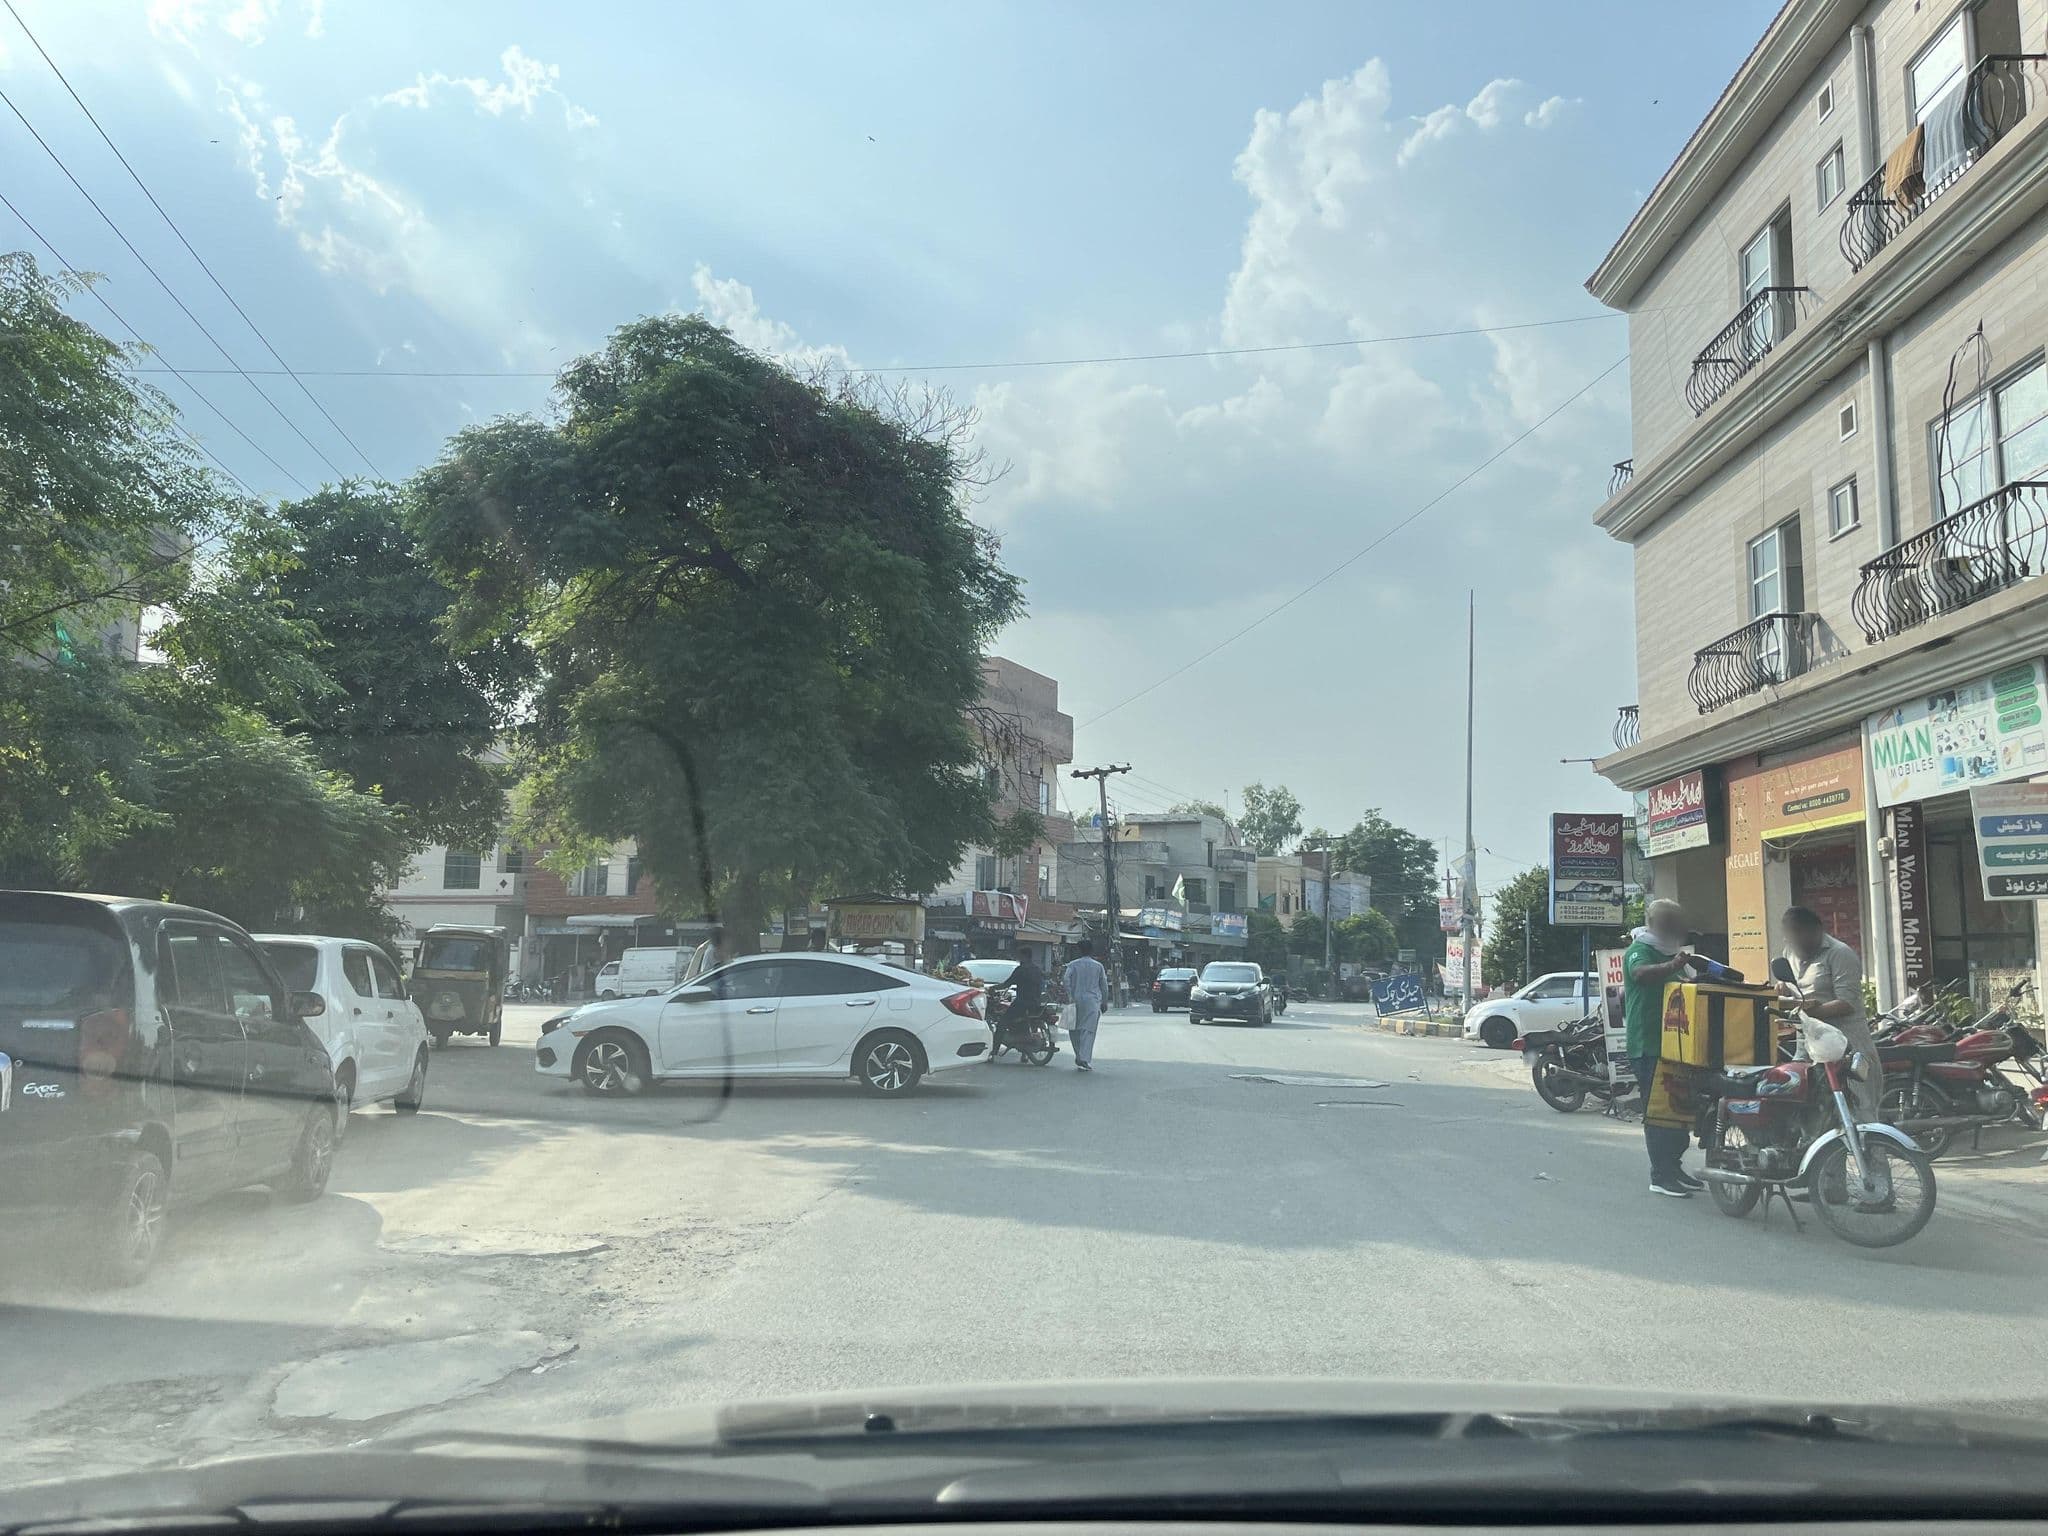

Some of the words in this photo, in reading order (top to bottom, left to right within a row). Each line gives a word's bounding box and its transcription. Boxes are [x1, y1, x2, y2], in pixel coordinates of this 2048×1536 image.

[1874, 725, 1932, 770] MIAN
[1890, 757, 1934, 778] MOBILES
[1996, 819, 2023, 833] کیش
[2024, 819, 2042, 832] جاز
[1728, 851, 1760, 869] REGALE
[2025, 847, 2048, 860] یزی
[2006, 879, 2024, 893] لوڈ
[2025, 879, 2048, 892] یزی
[1378, 978, 1400, 1010] چوک
[23, 1083, 59, 1094] Exec
